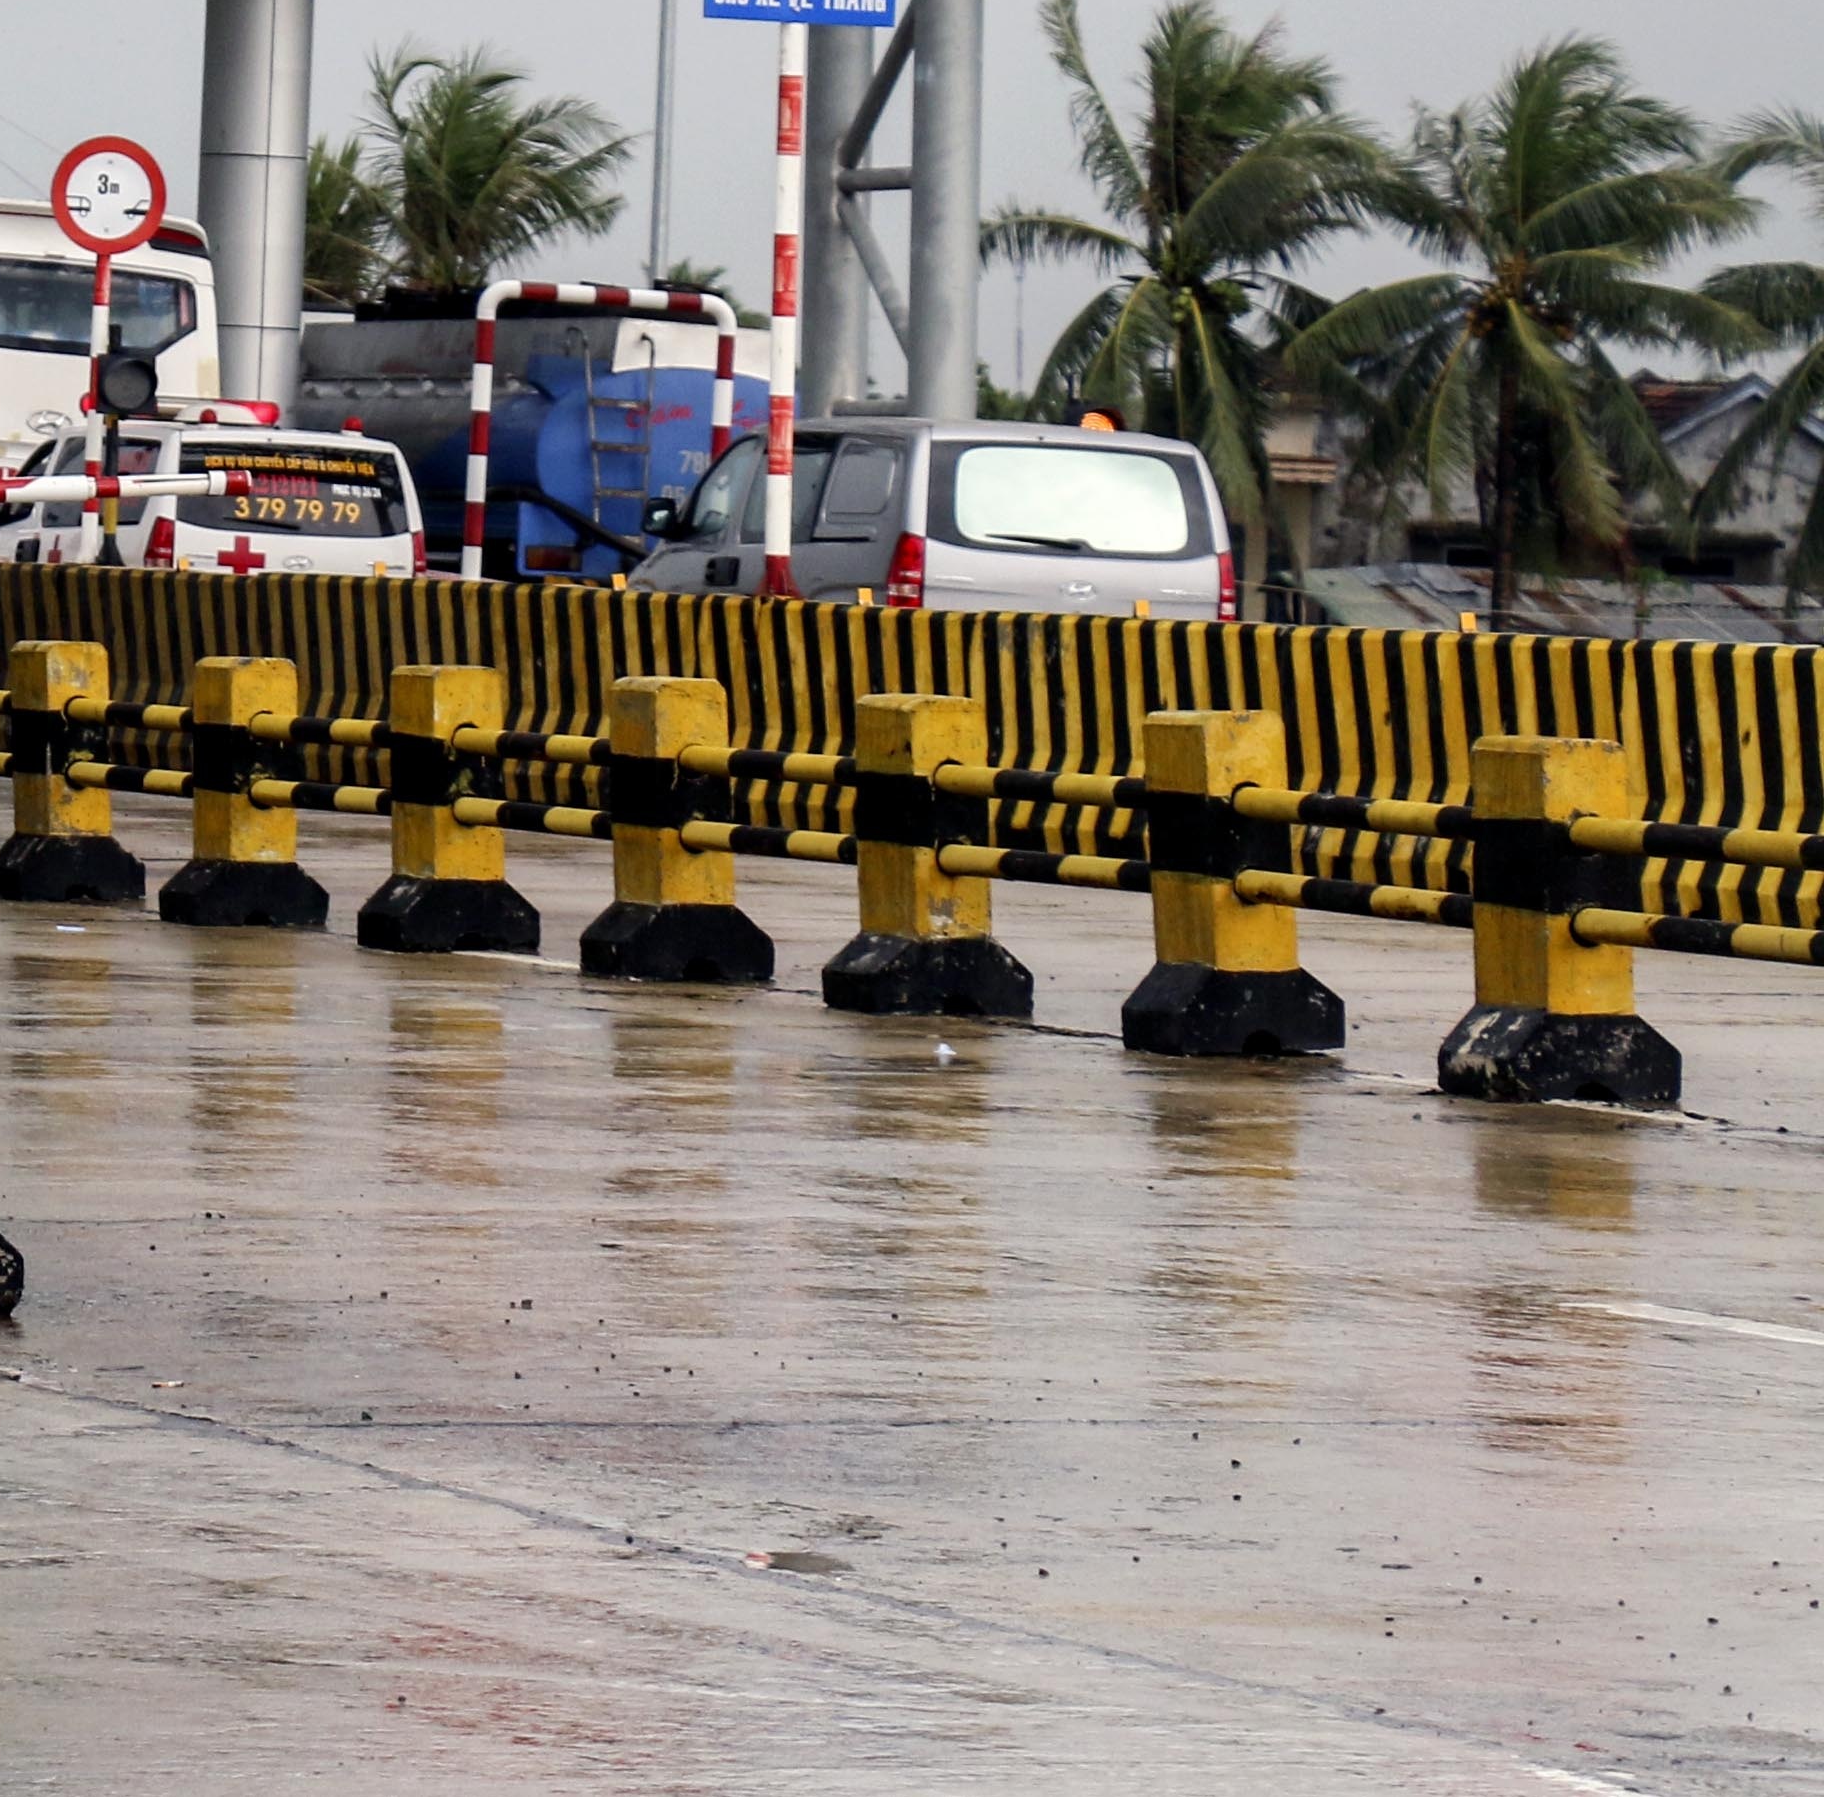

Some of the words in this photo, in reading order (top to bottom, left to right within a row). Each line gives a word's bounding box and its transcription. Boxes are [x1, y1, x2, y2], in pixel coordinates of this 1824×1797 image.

[235, 497, 250, 519] 3
[257, 498, 286, 519] 79
[294, 499, 324, 521] 79
[332, 501, 361, 524] 79
